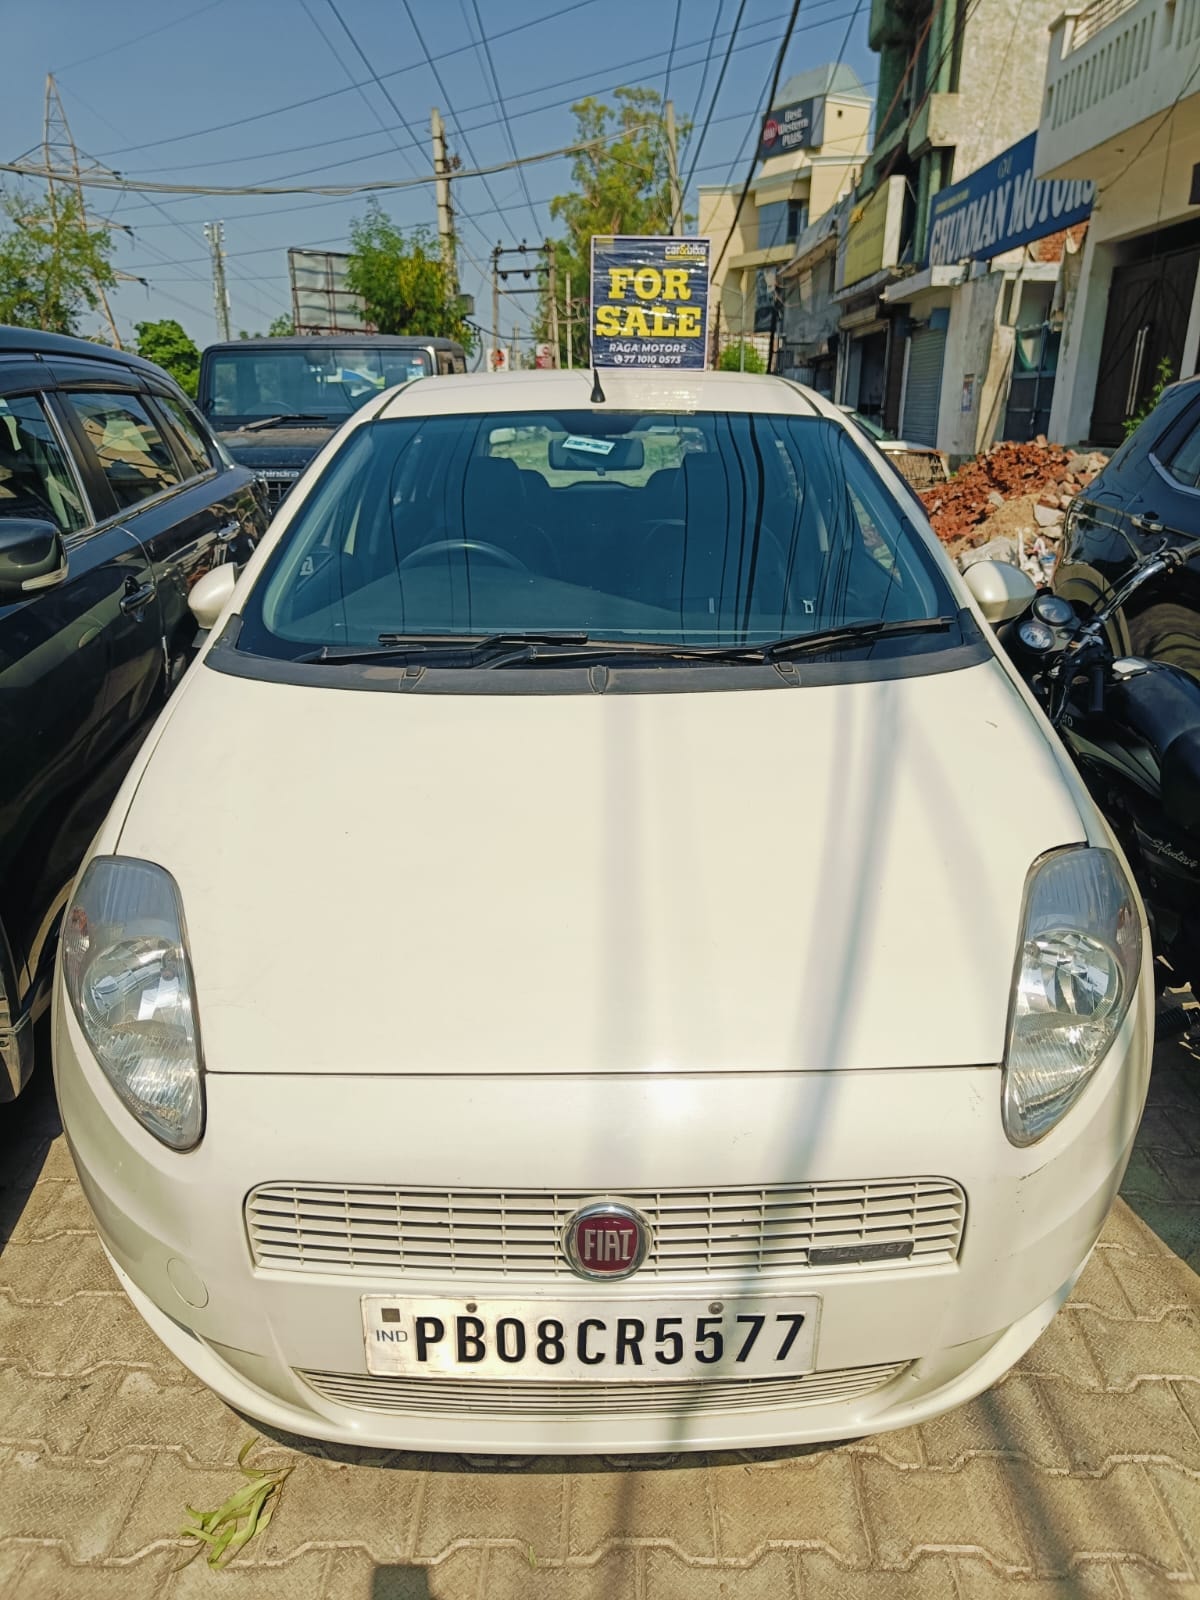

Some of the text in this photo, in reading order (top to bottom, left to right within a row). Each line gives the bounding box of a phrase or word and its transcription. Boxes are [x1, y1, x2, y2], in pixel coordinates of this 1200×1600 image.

[608, 268, 691, 300] FOR
[596, 305, 701, 337] SALE
[609, 342, 687, 353] RAGA MOTORS
[623, 355, 682, 364] 77 1010 0573
[255, 469, 300, 478] ahindra
[584, 1229, 633, 1261] FIAT
[376, 1329, 408, 1343] IND
[415, 1314, 805, 1365] PB08CR5577
